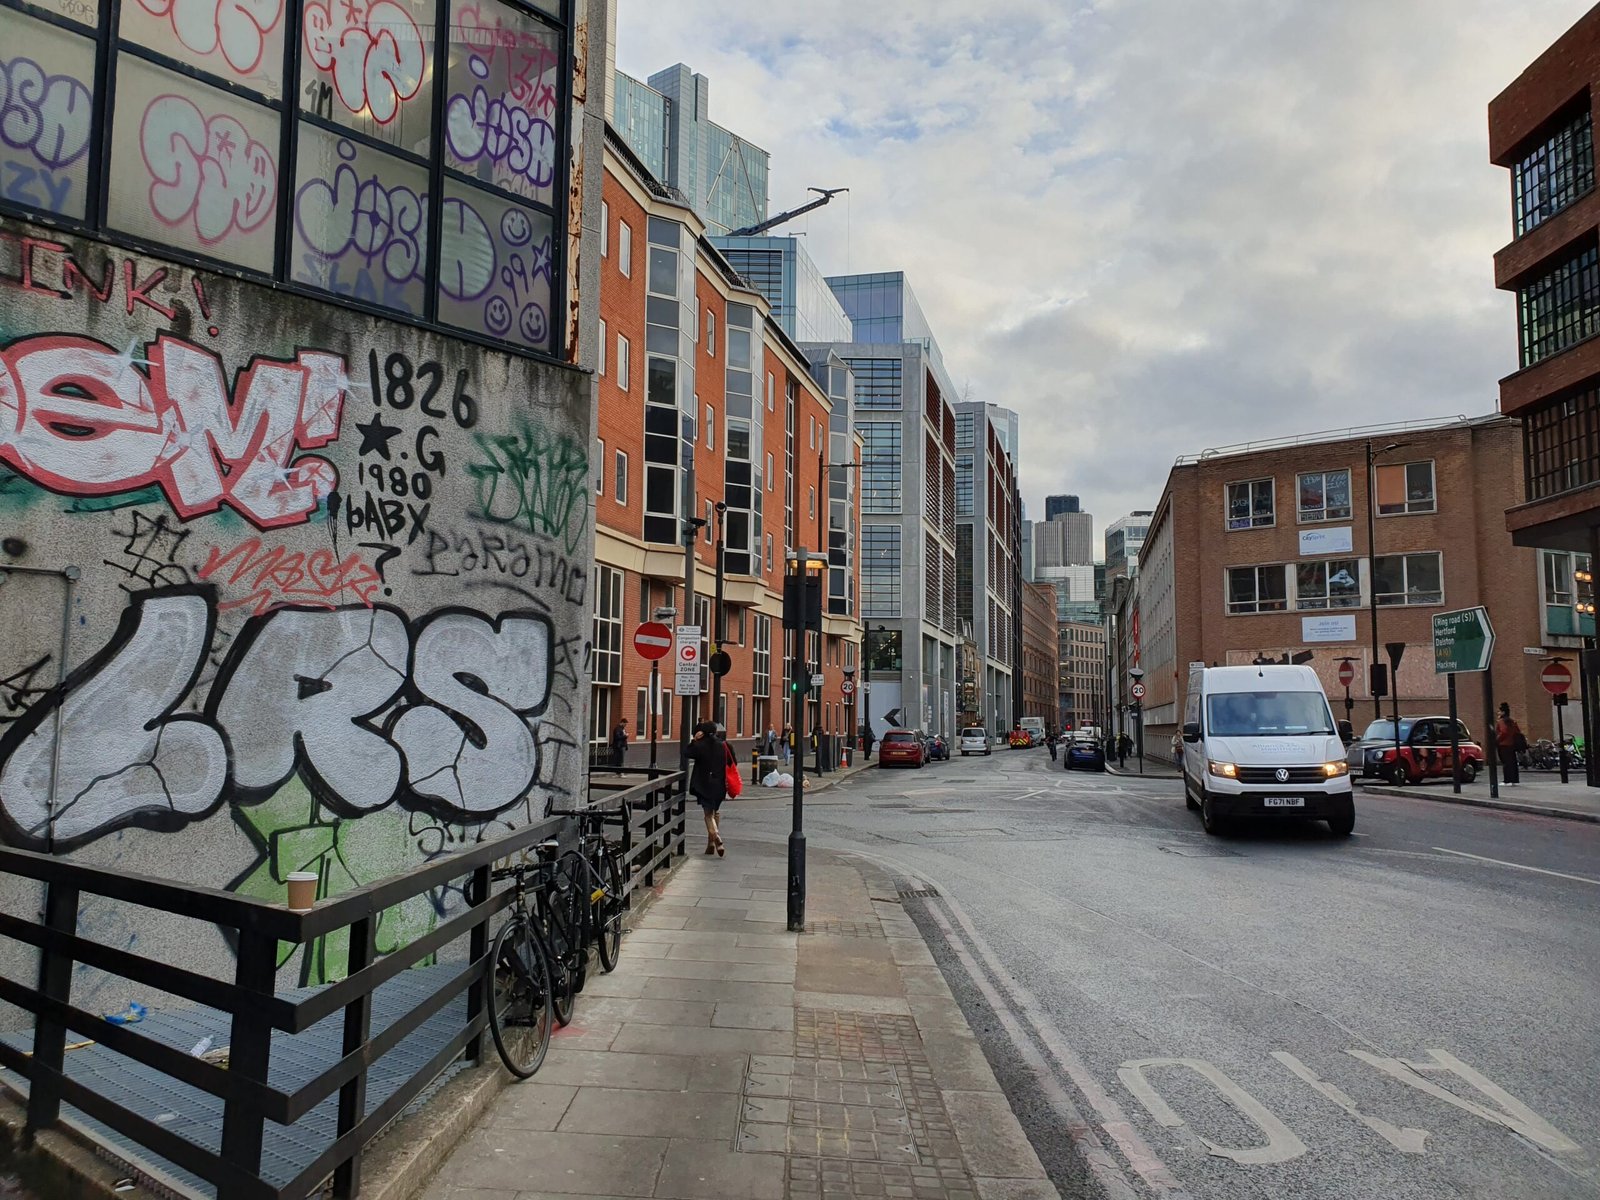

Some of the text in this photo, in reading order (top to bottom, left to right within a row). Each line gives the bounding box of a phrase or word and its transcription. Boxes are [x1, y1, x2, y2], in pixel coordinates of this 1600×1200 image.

[368, 347, 477, 429] 1826
[358, 462, 433, 500] 1980
[1449, 615, 1461, 625] road
[1435, 625, 1457, 636] Hertford
[1435, 637, 1455, 647] Dalston
[1436, 661, 1458, 670] Hackney
